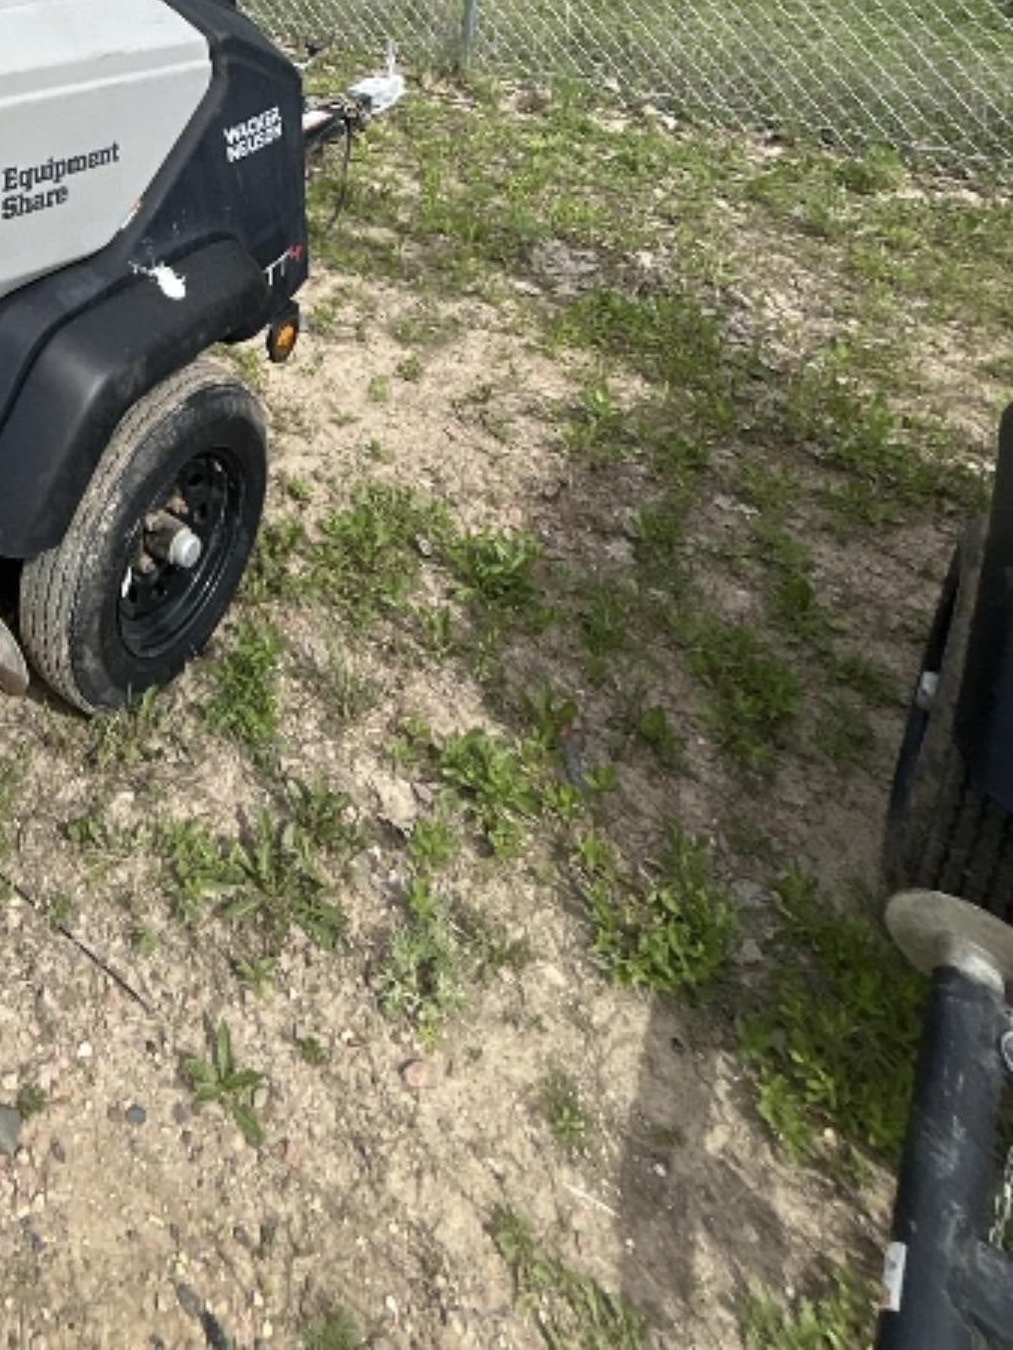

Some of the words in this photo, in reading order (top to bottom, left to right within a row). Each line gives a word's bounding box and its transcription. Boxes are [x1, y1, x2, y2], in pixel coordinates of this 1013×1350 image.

[223, 106, 282, 145] WACKER
[226, 122, 282, 163] NEUSON
[2, 141, 120, 192] Equipment
[1, 185, 69, 219] Share
